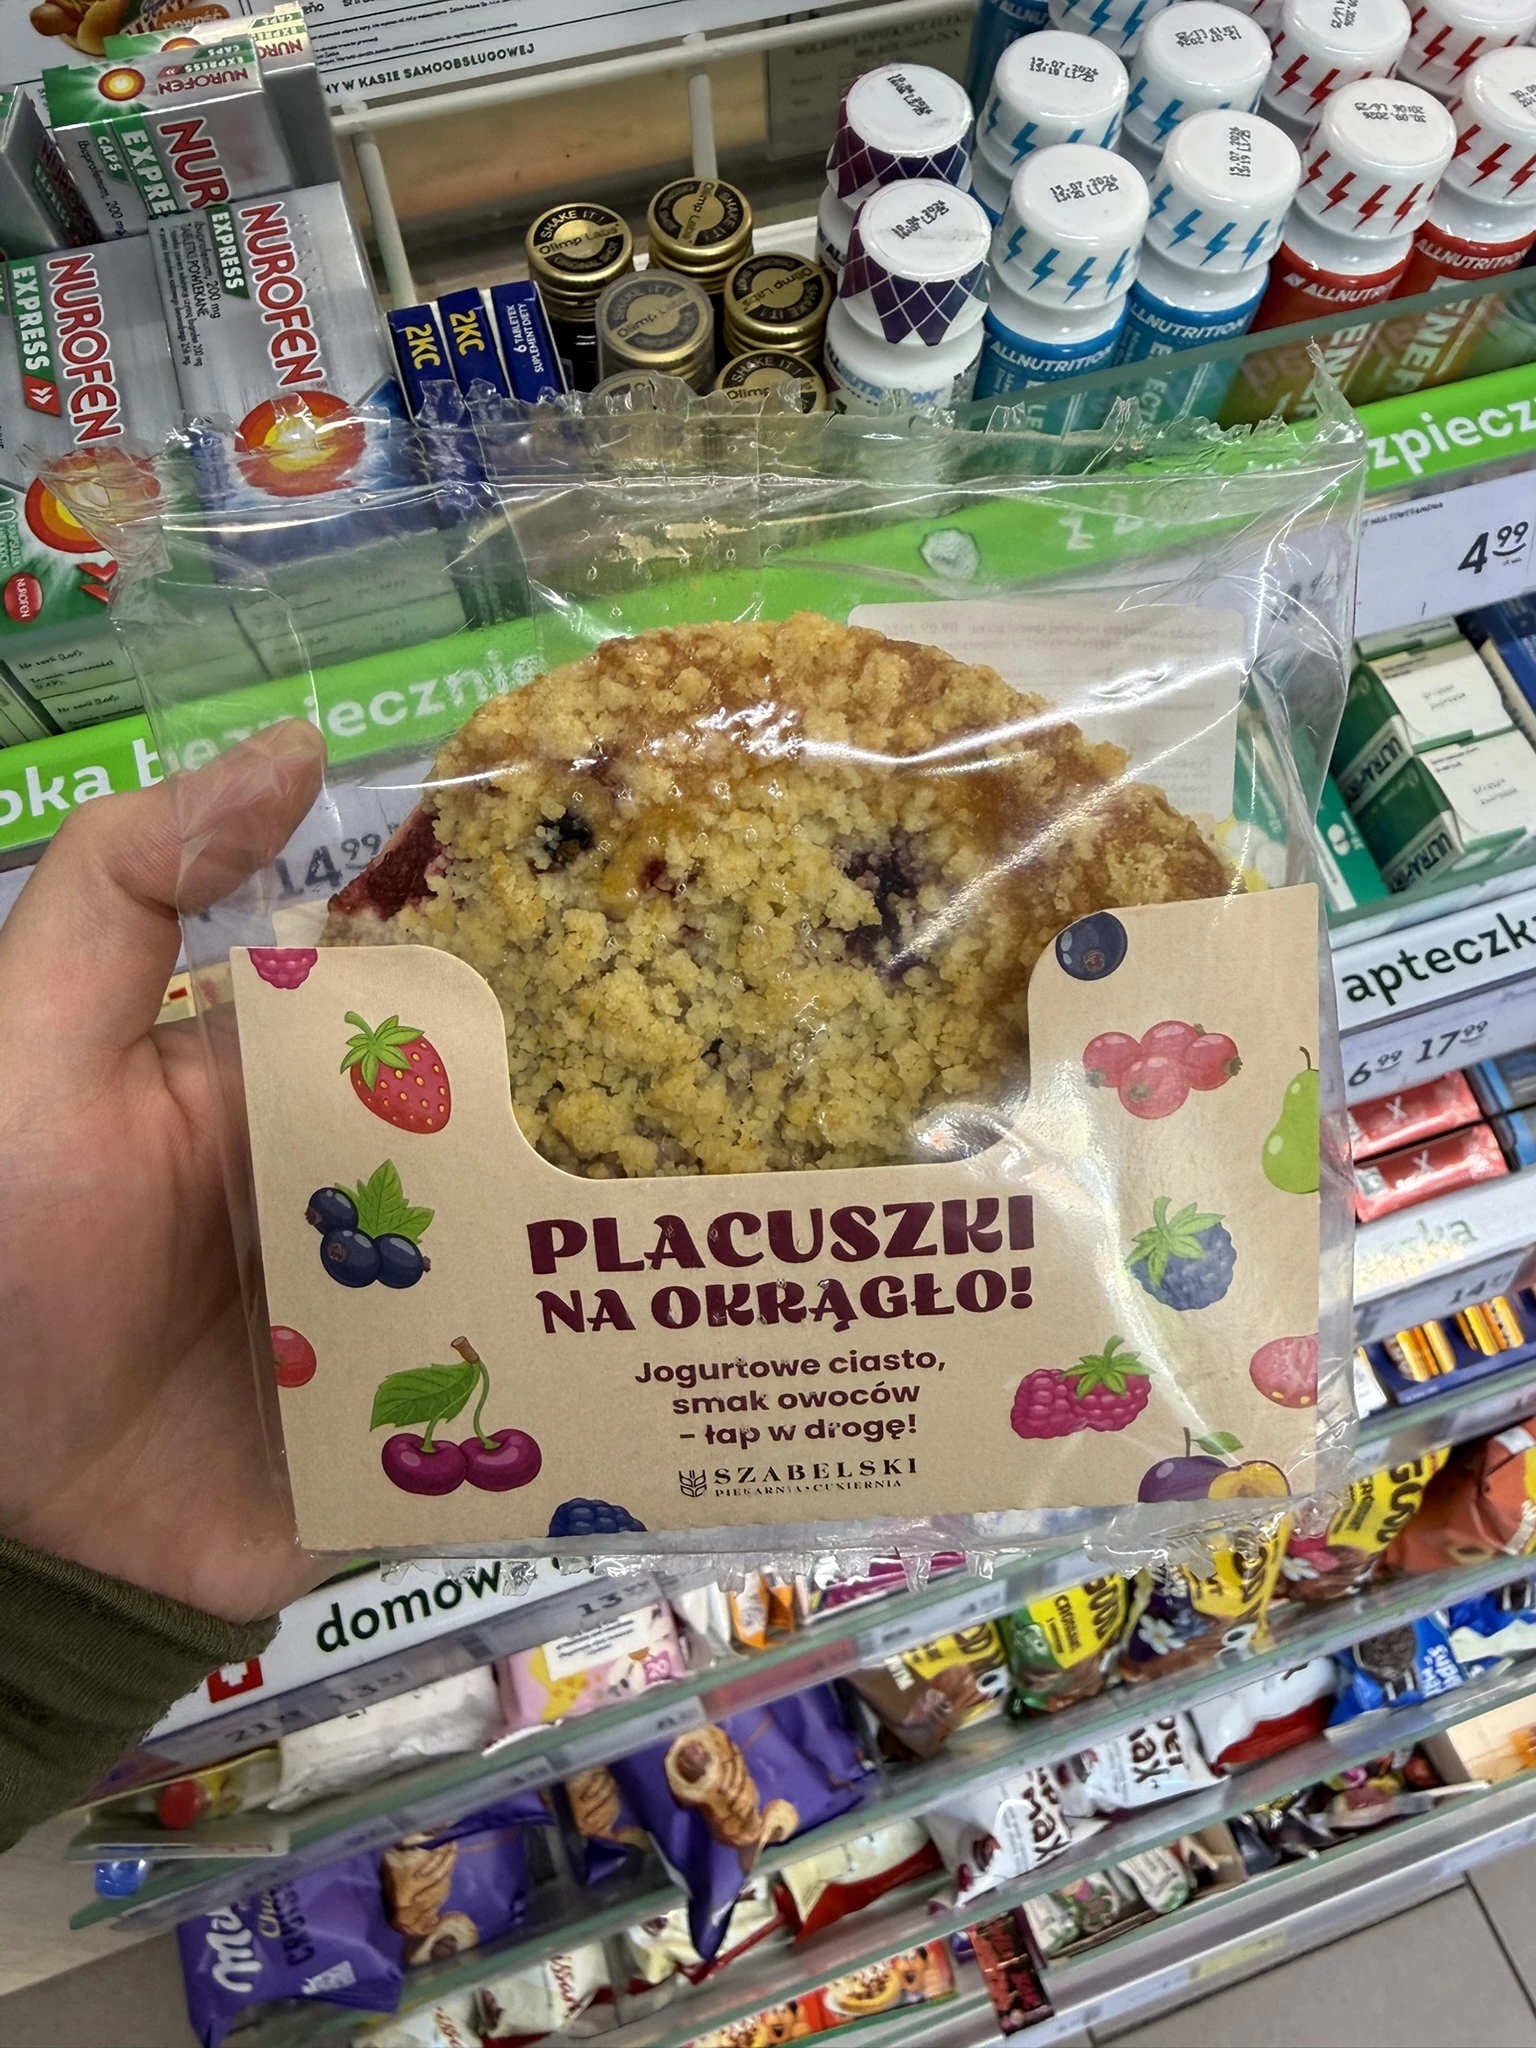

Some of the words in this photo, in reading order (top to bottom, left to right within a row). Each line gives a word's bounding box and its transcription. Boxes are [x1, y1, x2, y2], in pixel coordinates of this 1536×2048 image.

[158, 68, 249, 95] NUROFEN
[184, 56, 244, 73] EXPRESS
[342, 79, 355, 91] W
[358, 69, 401, 88] KASIE
[97, 136, 122, 172] CAPS
[120, 129, 178, 215] EXPRE
[540, 210, 577, 239] SHAKE
[211, 211, 245, 290] EXPRESS
[184, 258, 210, 317] POWLEKANE
[206, 279, 221, 301] 200
[240, 203, 323, 386] NUROFEN
[13, 266, 49, 370] EXPRESS
[208, 302, 222, 319] mg
[1130, 303, 1247, 339] LLNUTRITION
[49, 255, 122, 441] NUROFEN
[405, 323, 441, 370] 2KC
[449, 310, 485, 356] 2KC
[514, 344, 527, 353] 6
[523, 326, 545, 373] SUPLEMENT
[732, 356, 774, 383] SHAKE
[16, 578, 30, 618] NUROFEN
[132, 649, 540, 788] beiecznie
[1341, 912, 1536, 1006] apteczk
[526, 1195, 1035, 1274] PLACUSZKI
[535, 1289, 637, 1334] NA
[650, 1266, 1034, 1333] OKRĄGŁO!
[635, 1356, 821, 1388] Jogurtowe
[829, 1349, 946, 1375] ciasto,
[672, 1389, 769, 1415] smak
[777, 1380, 920, 1410] owoców
[705, 1424, 760, 1450] łap
[768, 1424, 797, 1442] w
[804, 1414, 917, 1443] drogę!
[714, 1458, 918, 1484] SZABELSKI
